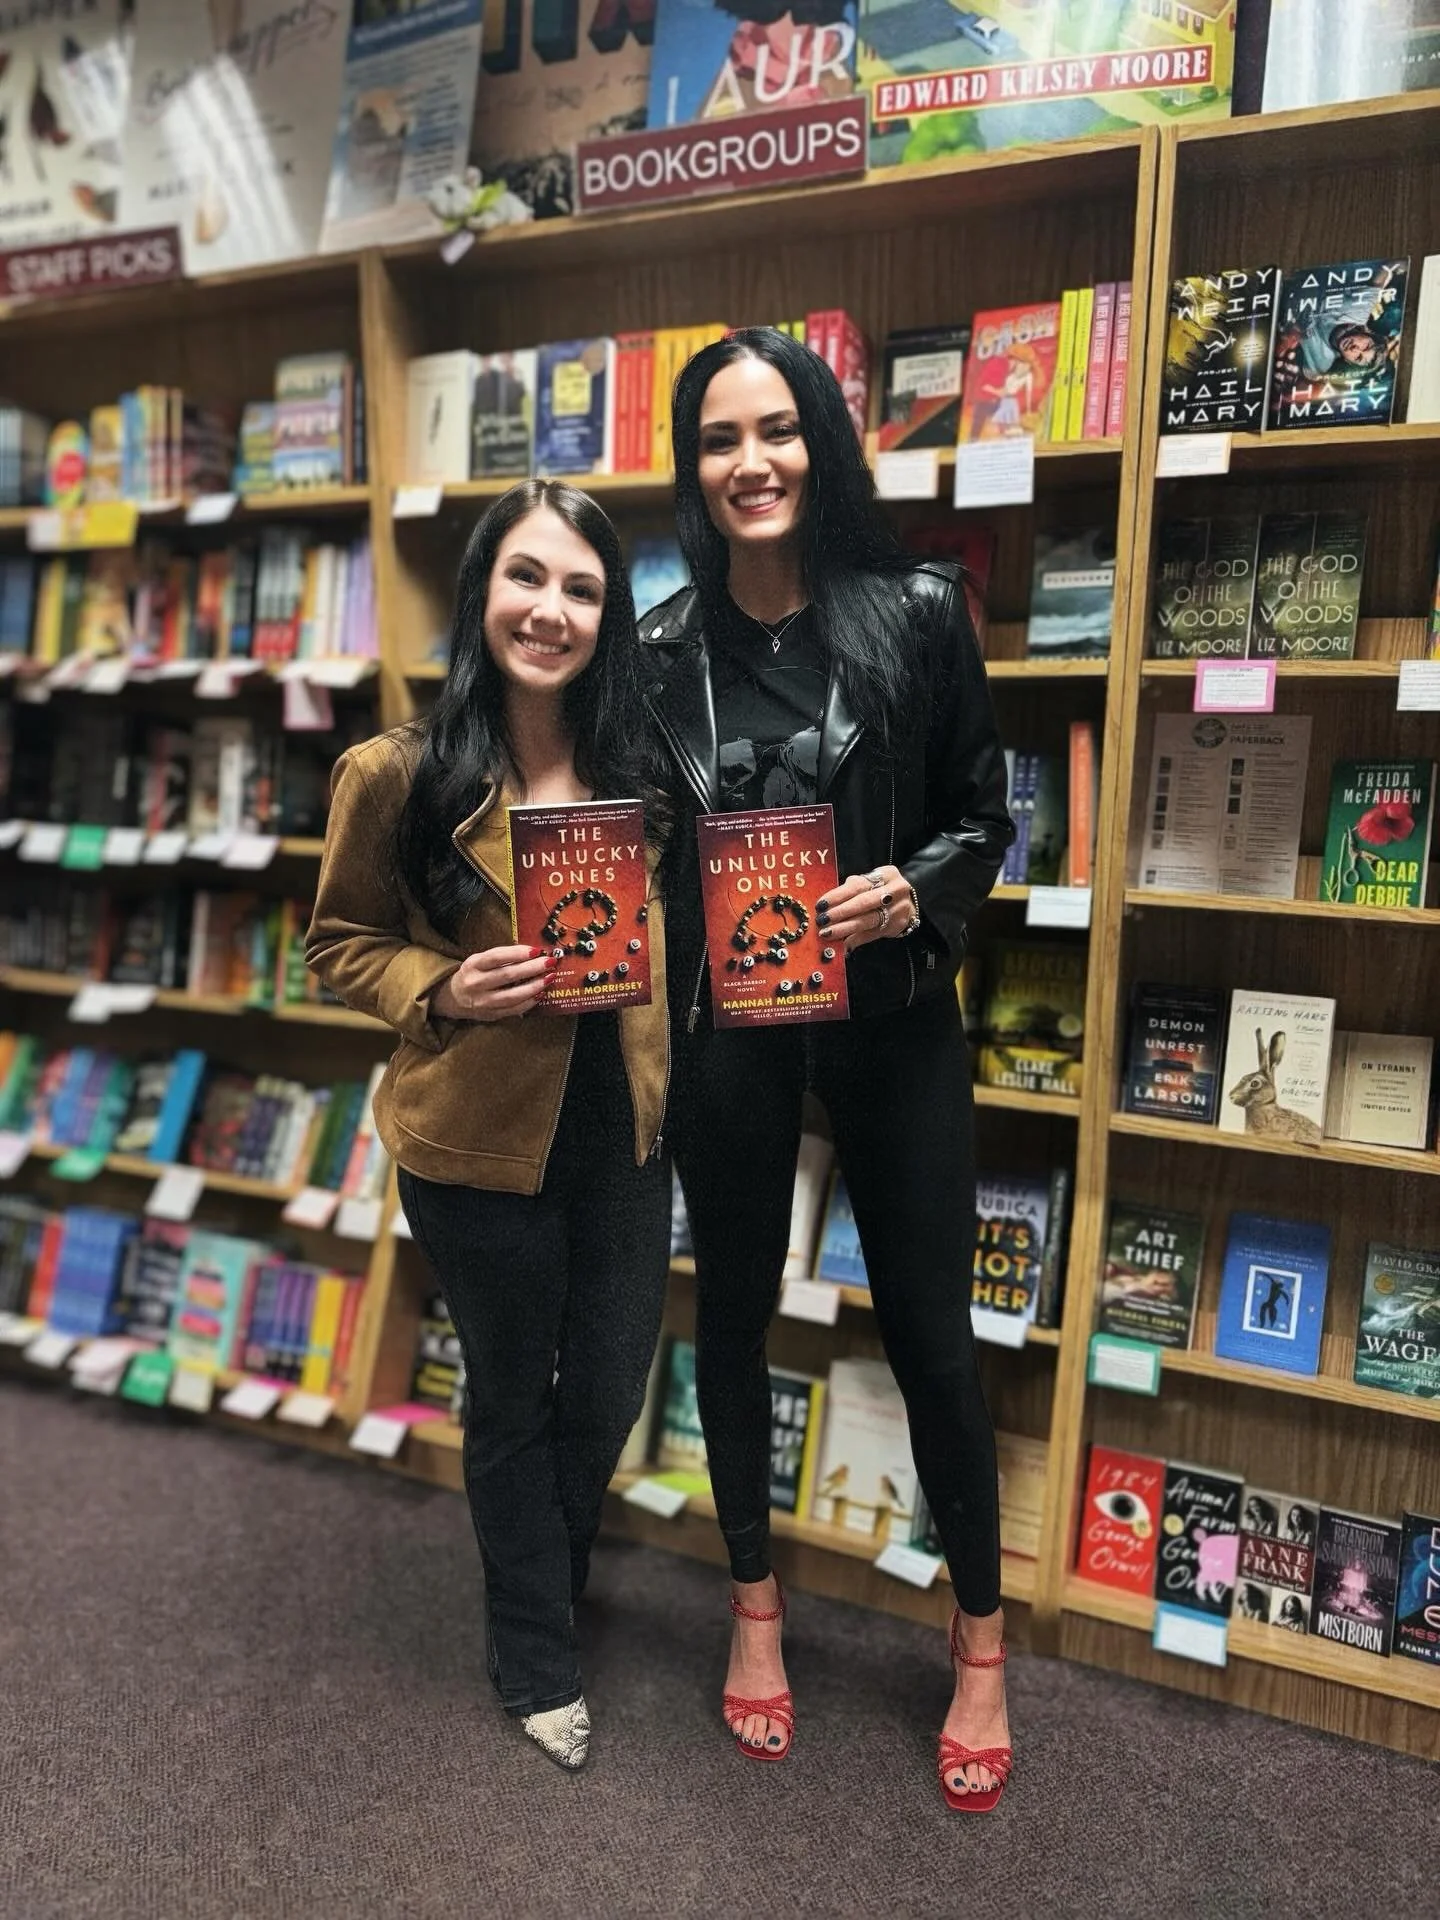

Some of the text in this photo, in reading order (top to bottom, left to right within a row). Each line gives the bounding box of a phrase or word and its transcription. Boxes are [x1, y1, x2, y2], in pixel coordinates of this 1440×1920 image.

[879, 49, 1209, 113] EDWARD KELSEY MOORE
[583, 118, 862, 196] BOOKGROUPS
[8, 238, 172, 293] STAFF PICKS
[1301, 263, 1400, 289] ANDY
[1180, 268, 1273, 297] ANDY
[1177, 294, 1271, 320] WEIR
[1300, 288, 1397, 312] WEIR
[1170, 379, 1262, 402] HAIL
[1292, 378, 1388, 401] HAIL
[1167, 402, 1261, 425] MARY
[1290, 394, 1386, 418] MARY
[1195, 559, 1249, 578] GOD
[1266, 555, 1358, 575] THE GOD
[1174, 584, 1232, 603] OF THE
[1278, 580, 1340, 599] OF THE
[1158, 608, 1246, 627] WOODS
[1260, 605, 1354, 624] WOODS
[1179, 638, 1241, 655] MOORE
[1257, 636, 1349, 652] LIZ MOORE
[1229, 735, 1285, 744] PAPERBACK
[1357, 772, 1410, 787] FREIDA
[1343, 789, 1421, 804] McFADDEN
[558, 827, 602, 844] THE
[744, 831, 790, 849] THE
[522, 845, 638, 868] UNLUCKY
[710, 849, 829, 874] UNLUCKY
[548, 867, 616, 886] ONES
[1375, 860, 1418, 882] DEAR
[736, 872, 806, 893] ONES
[1355, 884, 1412, 907] DEBBIE
[545, 981, 643, 999] NNAH MORRISSEY
[723, 992, 839, 1010] HANNAH MORRISSEY
[1148, 1017, 1205, 1032] DEMON
[1145, 1038, 1206, 1053] UNREST
[1015, 1058, 1054, 1076] CLARE
[1361, 1062, 1416, 1074] ON TYRANNY
[994, 1072, 1076, 1095] LESLIE HALL
[1154, 1072, 1190, 1087] ERIK
[1134, 1086, 1206, 1106] LARSON
[977, 1197, 1037, 1217] UBICA
[977, 1221, 1030, 1249] IT'S
[1136, 1229, 1177, 1249] ART
[1125, 1245, 1184, 1271] THIEF
[1373, 1253, 1412, 1269] DAVID
[972, 1281, 1029, 1310] HER
[1394, 1328, 1425, 1341] THE
[1096, 1464, 1158, 1493] 1984
[1165, 1477, 1235, 1513] Animal
[1185, 1505, 1237, 1533] Farm
[1088, 1519, 1144, 1558] George
[1334, 1525, 1385, 1553] BRANDON
[1089, 1546, 1150, 1582] Orwell
[1244, 1540, 1309, 1568] ANNE
[1321, 1541, 1393, 1579] SANDERSON
[1243, 1552, 1305, 1582] FRANK
[1317, 1611, 1383, 1653] MISTBORN
[1400, 1640, 1431, 1657] FRANK
